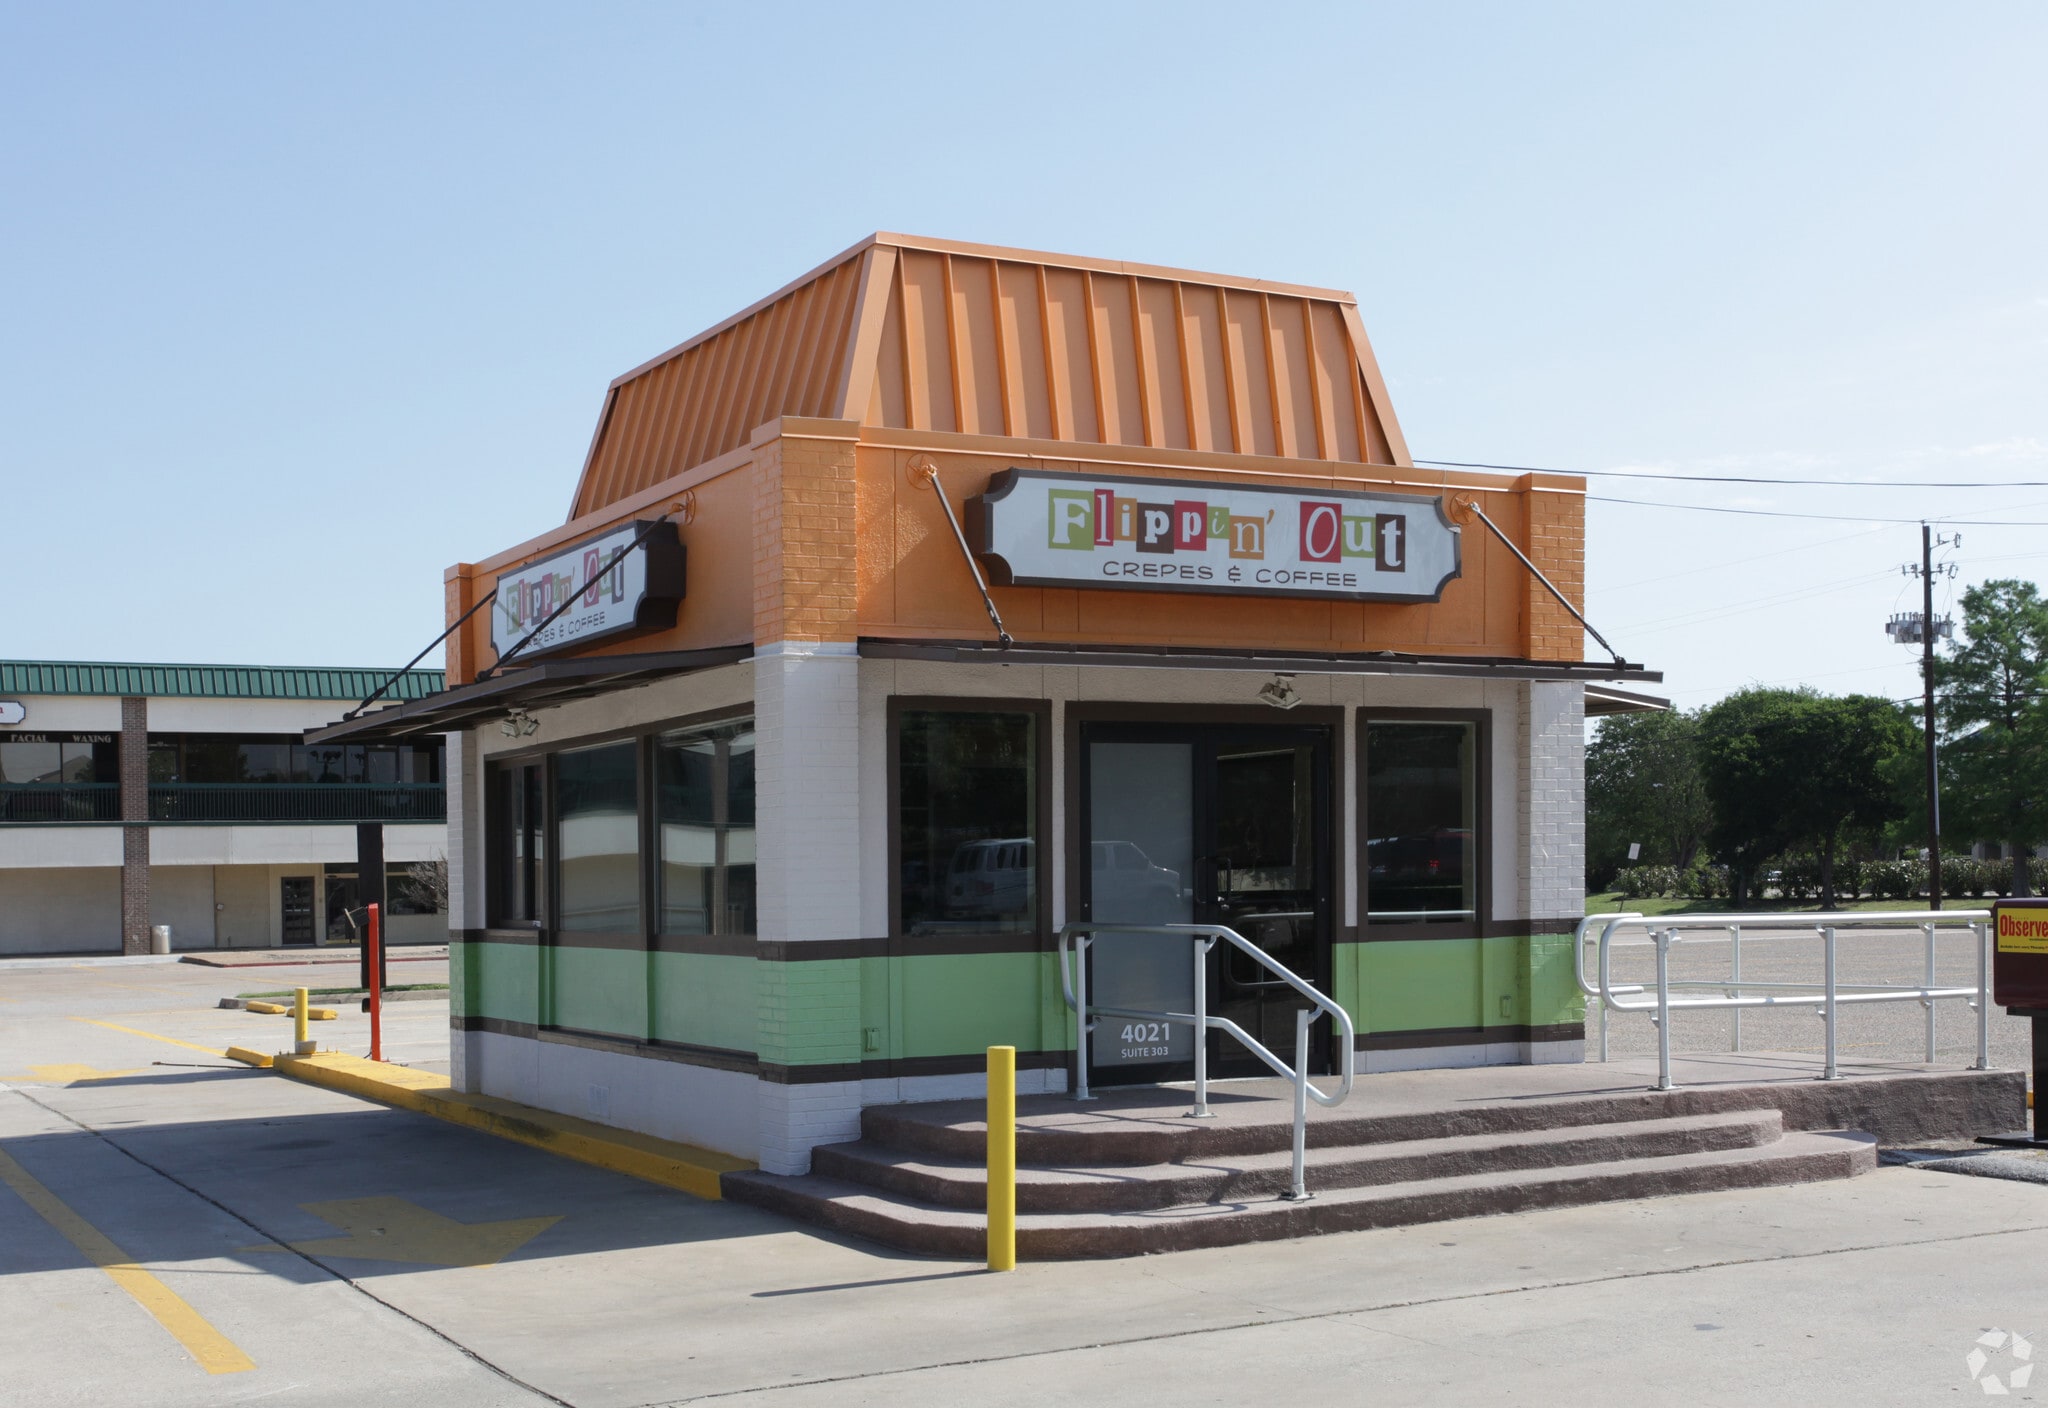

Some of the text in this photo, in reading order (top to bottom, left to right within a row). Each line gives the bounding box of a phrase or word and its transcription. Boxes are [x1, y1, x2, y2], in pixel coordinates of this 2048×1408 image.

[1051, 493, 1402, 567] Flippin' Out
[1102, 560, 1358, 587] CREPES & COFFEE
[568, 611, 606, 635] COFFEE
[10, 734, 112, 743] FACIAL WAXING
[1121, 1022, 1170, 1043] 4021
[1121, 1046, 1169, 1058] SUITE 303
